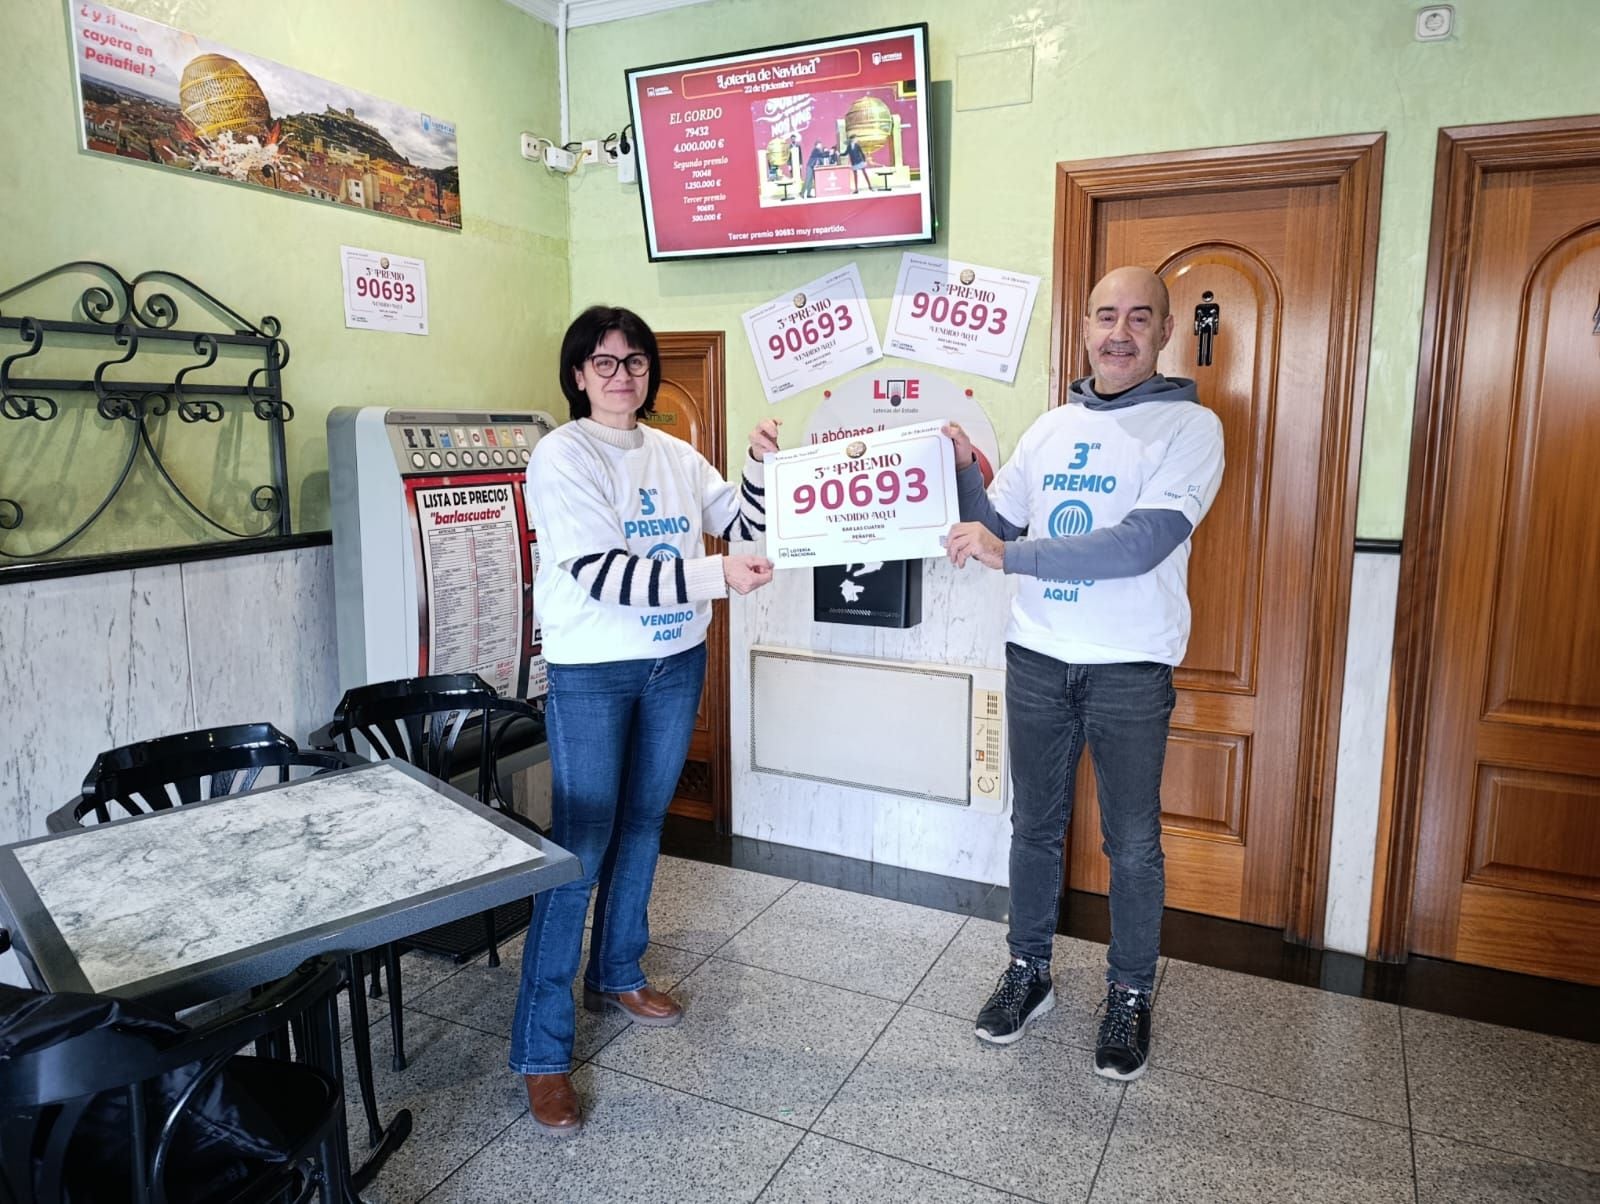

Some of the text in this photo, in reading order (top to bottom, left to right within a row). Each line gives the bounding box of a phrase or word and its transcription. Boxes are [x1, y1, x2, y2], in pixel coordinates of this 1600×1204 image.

[92, 10, 101, 22] y
[106, 14, 116, 26] si
[83, 29, 153, 58] cayera en
[85, 46, 156, 78] Peñafiel ?
[758, 68, 771, 81] de
[772, 57, 821, 80] Navidad
[669, 107, 722, 125] EL GORDO
[685, 126, 709, 138] 79432
[673, 138, 725, 153] 4.000.000 €
[673, 155, 729, 171] Segundo premio
[683, 194, 727, 205] Tercer premio
[728, 232, 749, 241] Tercer
[750, 230, 774, 241] premio
[796, 227, 811, 237] muy
[812, 224, 847, 235] repartido.
[374, 269, 405, 282] PREMIO
[356, 276, 416, 304] 90693
[946, 283, 996, 304] PREMIO
[788, 297, 832, 325] PREMIO
[910, 291, 1008, 335] 90693
[768, 304, 853, 360] 90693
[822, 427, 874, 444] abónate
[833, 453, 902, 477] PREMIO
[793, 467, 929, 515] 90693
[1042, 473, 1117, 495] PREMIO
[423, 488, 508, 509] LISTA DE PRECIOS
[826, 511, 869, 524] VENDIDO
[624, 515, 691, 540] PREMIO
[1043, 587, 1079, 603] AQUÍ
[640, 609, 694, 627] VENDIDO
[653, 624, 683, 642] AQUÍ
